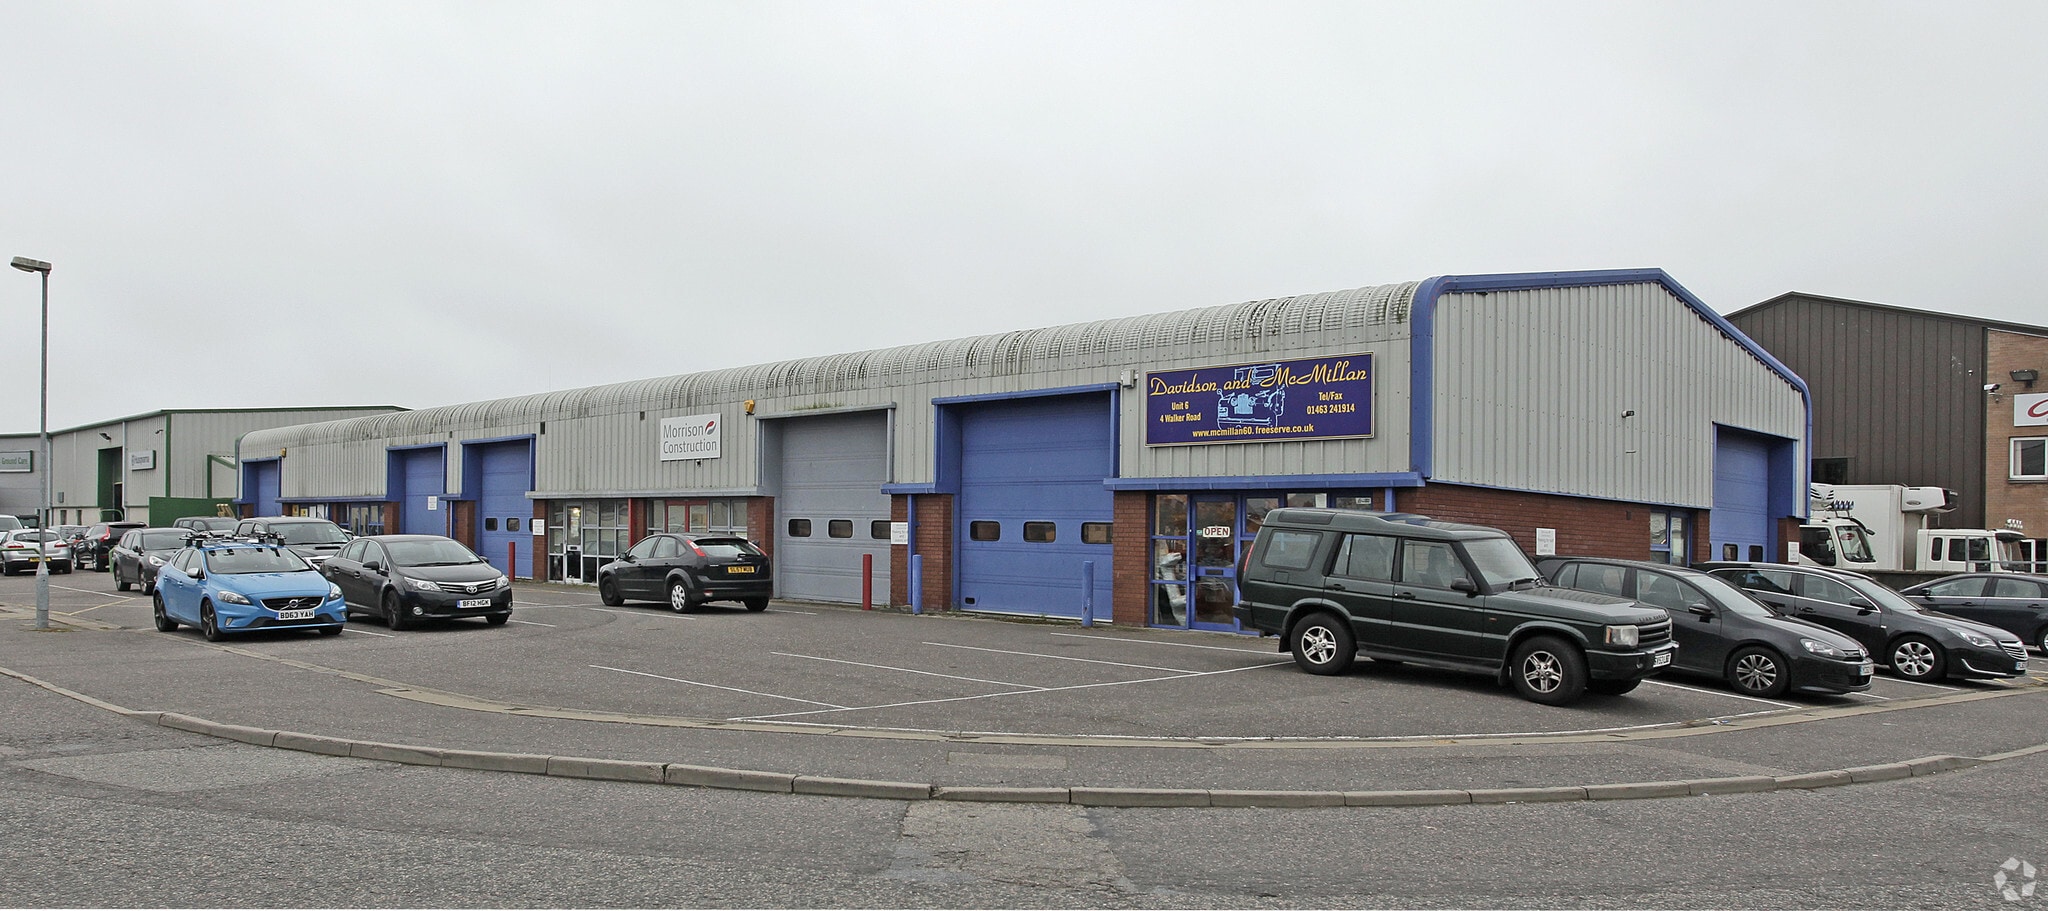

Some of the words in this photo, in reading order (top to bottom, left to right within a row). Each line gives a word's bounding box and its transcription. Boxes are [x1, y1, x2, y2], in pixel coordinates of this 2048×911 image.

[1150, 373, 1217, 396] Davidson
[1223, 368, 1253, 390] and
[1260, 360, 1367, 388] McMillan
[1318, 391, 1343, 401] Tel/Fax
[1171, 402, 1184, 411] Unit
[1184, 401, 1189, 410] 6
[1306, 405, 1328, 415] 01463
[1329, 403, 1355, 414] 241914
[1159, 415, 1164, 423] 4
[1165, 414, 1184, 423] Walker
[1185, 412, 1202, 421] Road
[663, 423, 704, 439] Morrison
[663, 438, 717, 454] Construction
[1204, 527, 1229, 536] OPEN
[280, 611, 299, 619] BD63
[300, 610, 314, 618] YAH
